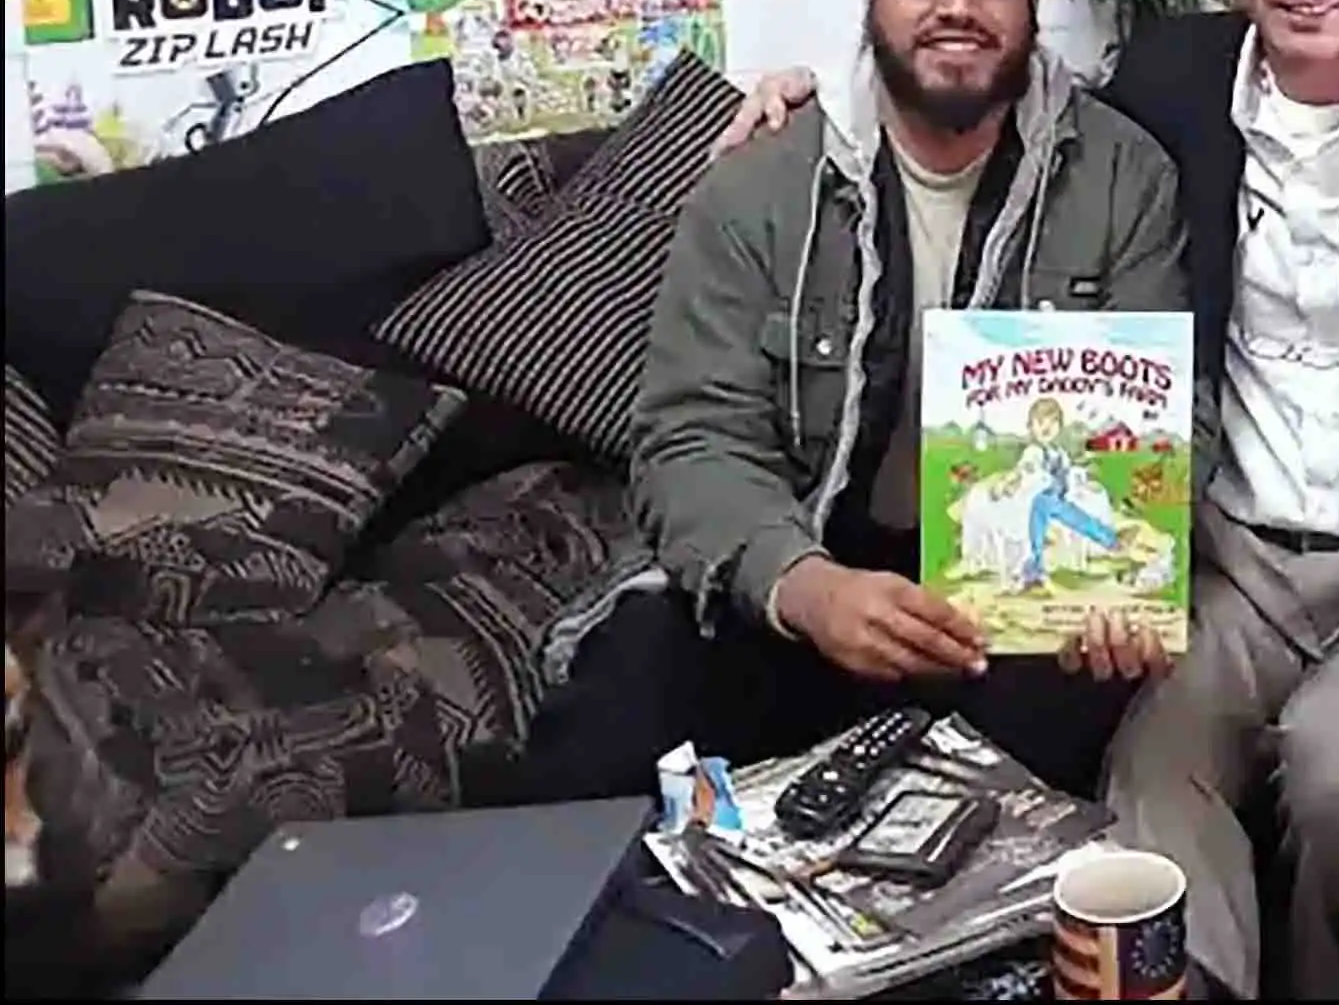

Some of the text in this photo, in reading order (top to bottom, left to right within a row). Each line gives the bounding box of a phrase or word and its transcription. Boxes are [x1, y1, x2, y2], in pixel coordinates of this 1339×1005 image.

[119, 21, 314, 66] ZIP LASH
[962, 348, 1172, 390] MY NEW BOOTS
[965, 386, 1002, 409] FOR
[1005, 377, 1034, 398] MY
